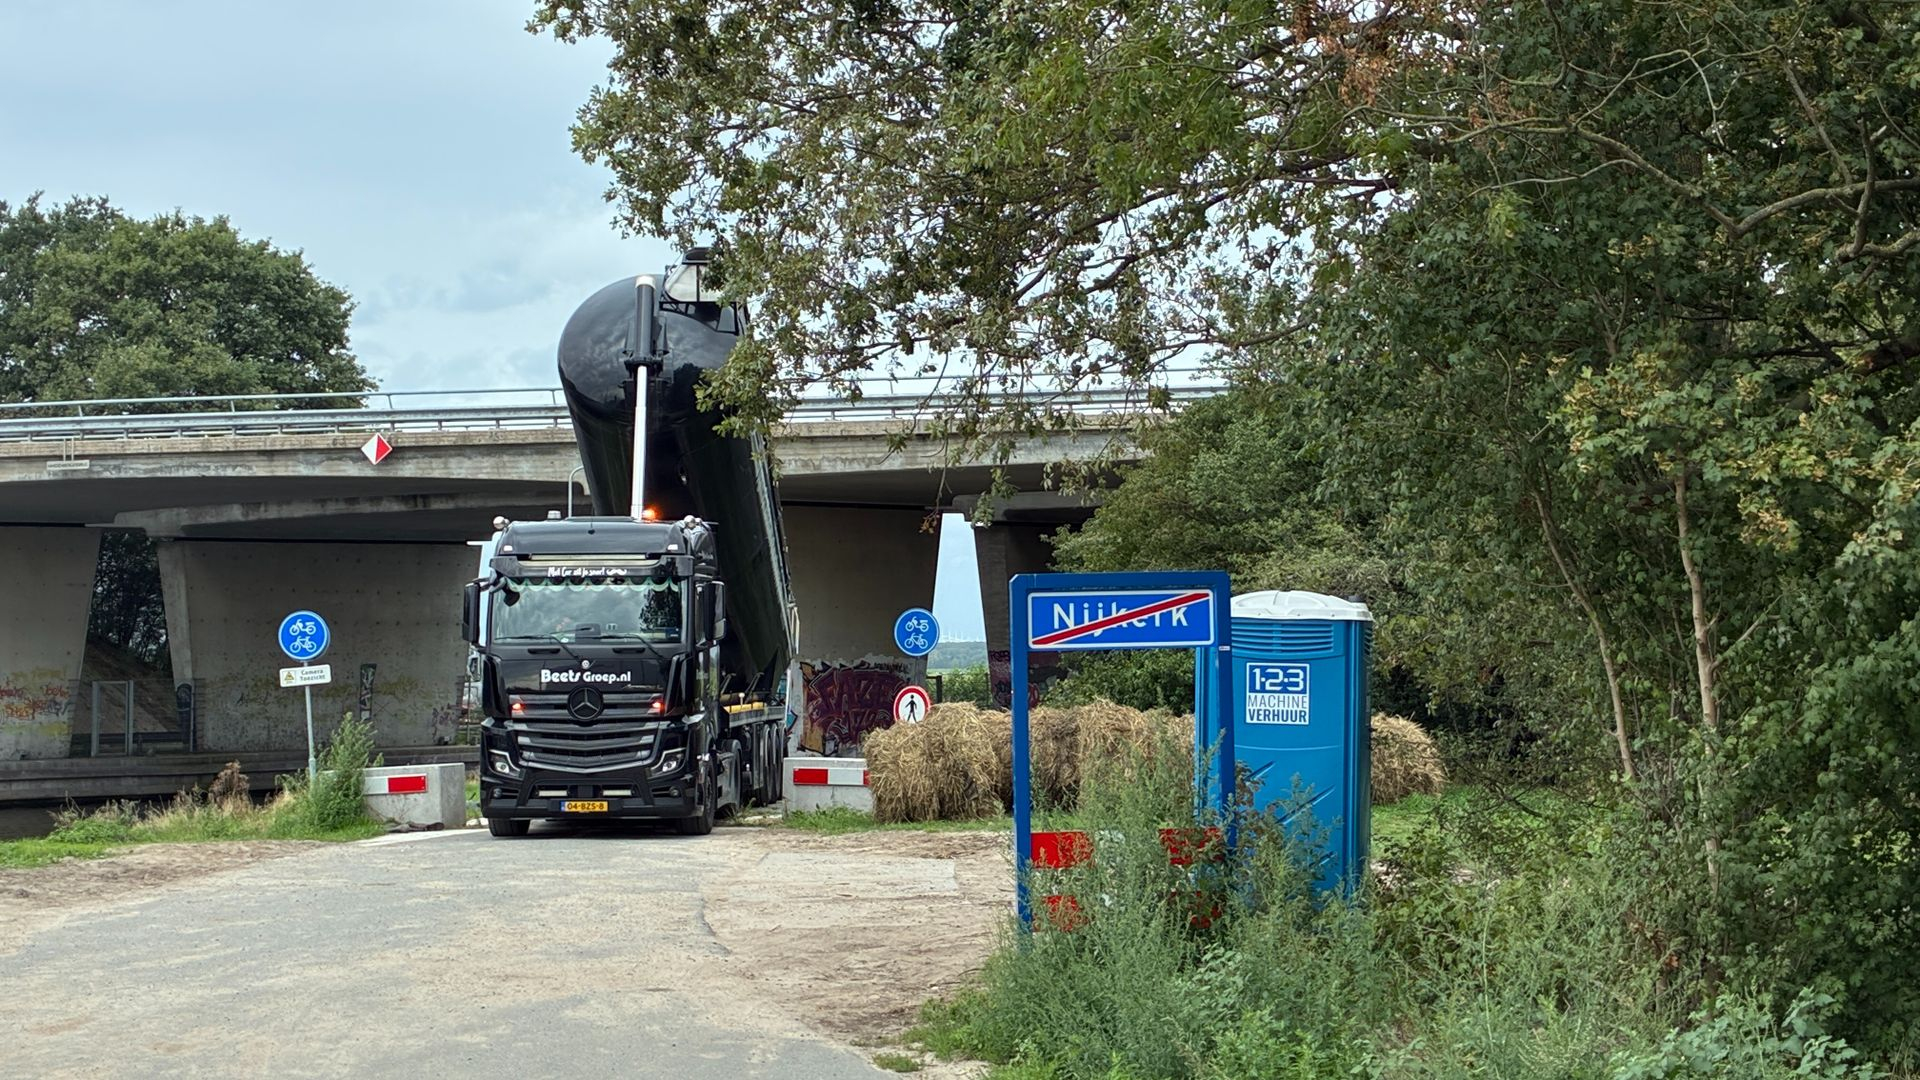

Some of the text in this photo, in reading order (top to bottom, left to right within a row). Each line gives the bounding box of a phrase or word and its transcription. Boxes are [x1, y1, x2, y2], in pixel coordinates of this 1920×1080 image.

[1053, 602, 1188, 637] Nijkerk
[301, 668, 324, 676] Camera
[540, 669, 631, 684] Beets Groep.nl
[1248, 695, 1307, 709] MACHINE
[1248, 708, 1307, 723] VERHUUR
[567, 802, 605, 810] 04-BZS-8
